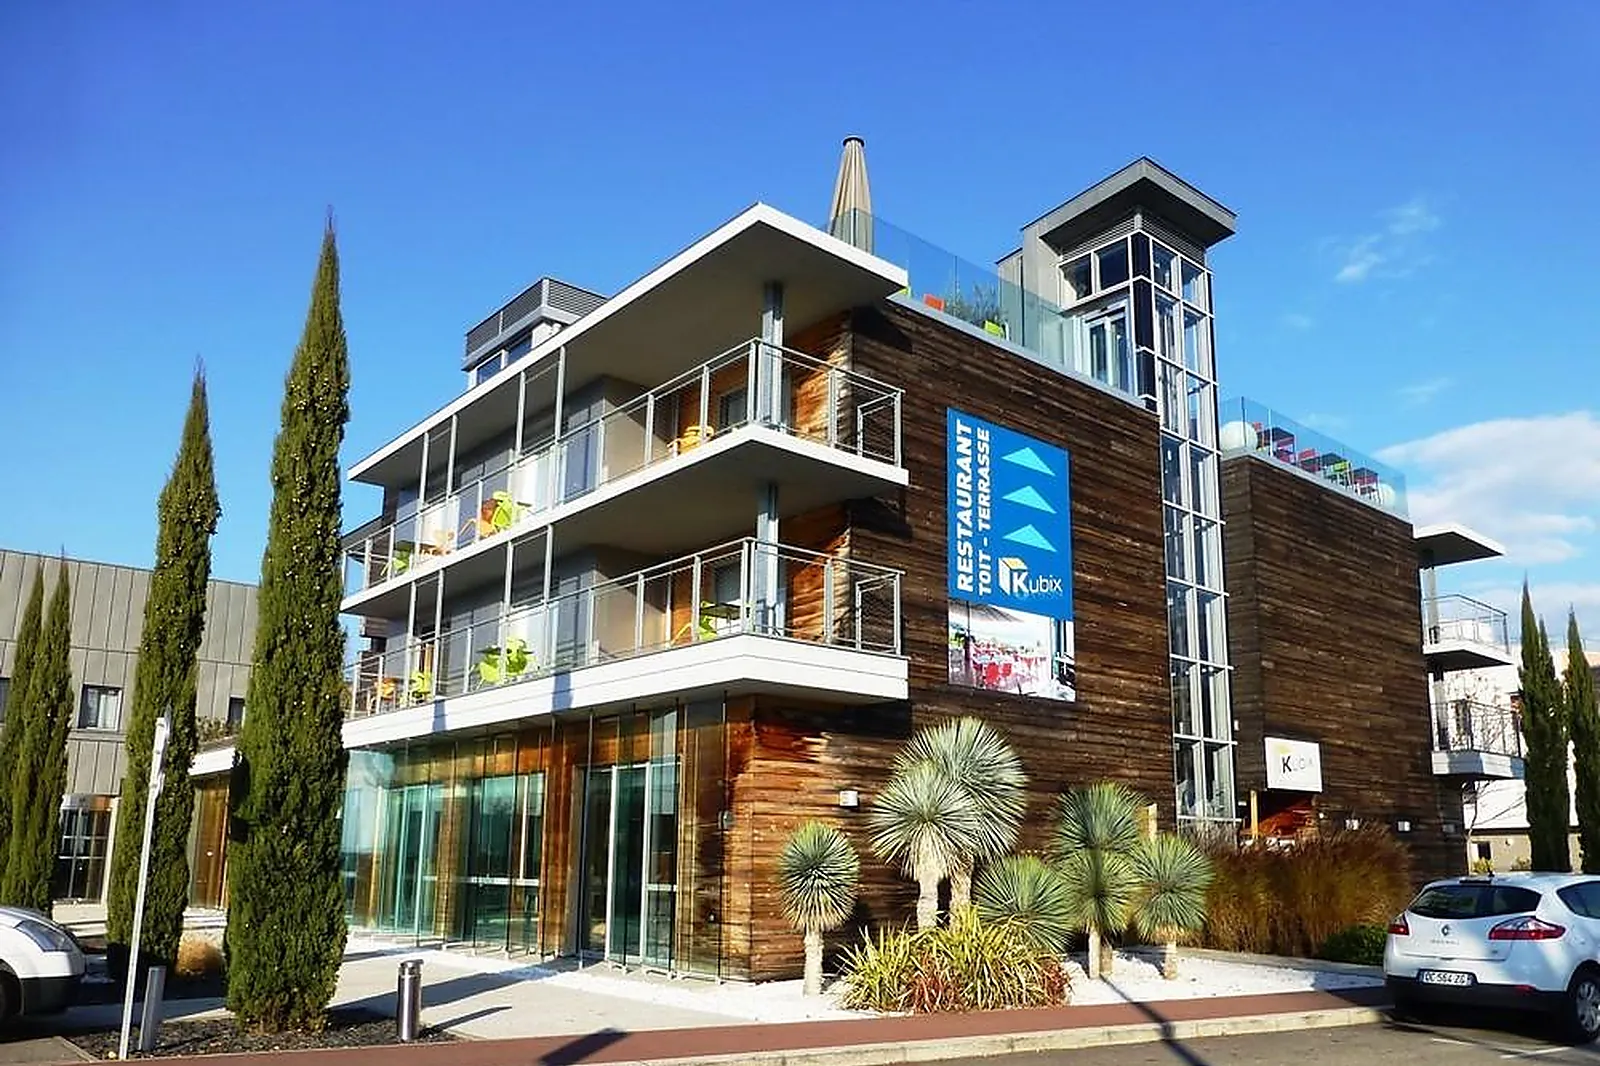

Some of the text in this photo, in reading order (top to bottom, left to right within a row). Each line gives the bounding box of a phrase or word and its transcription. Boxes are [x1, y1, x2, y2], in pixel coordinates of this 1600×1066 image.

[956, 417, 974, 592] RESTAURANT
[977, 426, 991, 532] TERRASSE
[978, 549, 992, 597] TOIT
[1012, 571, 1063, 594] Kubix
